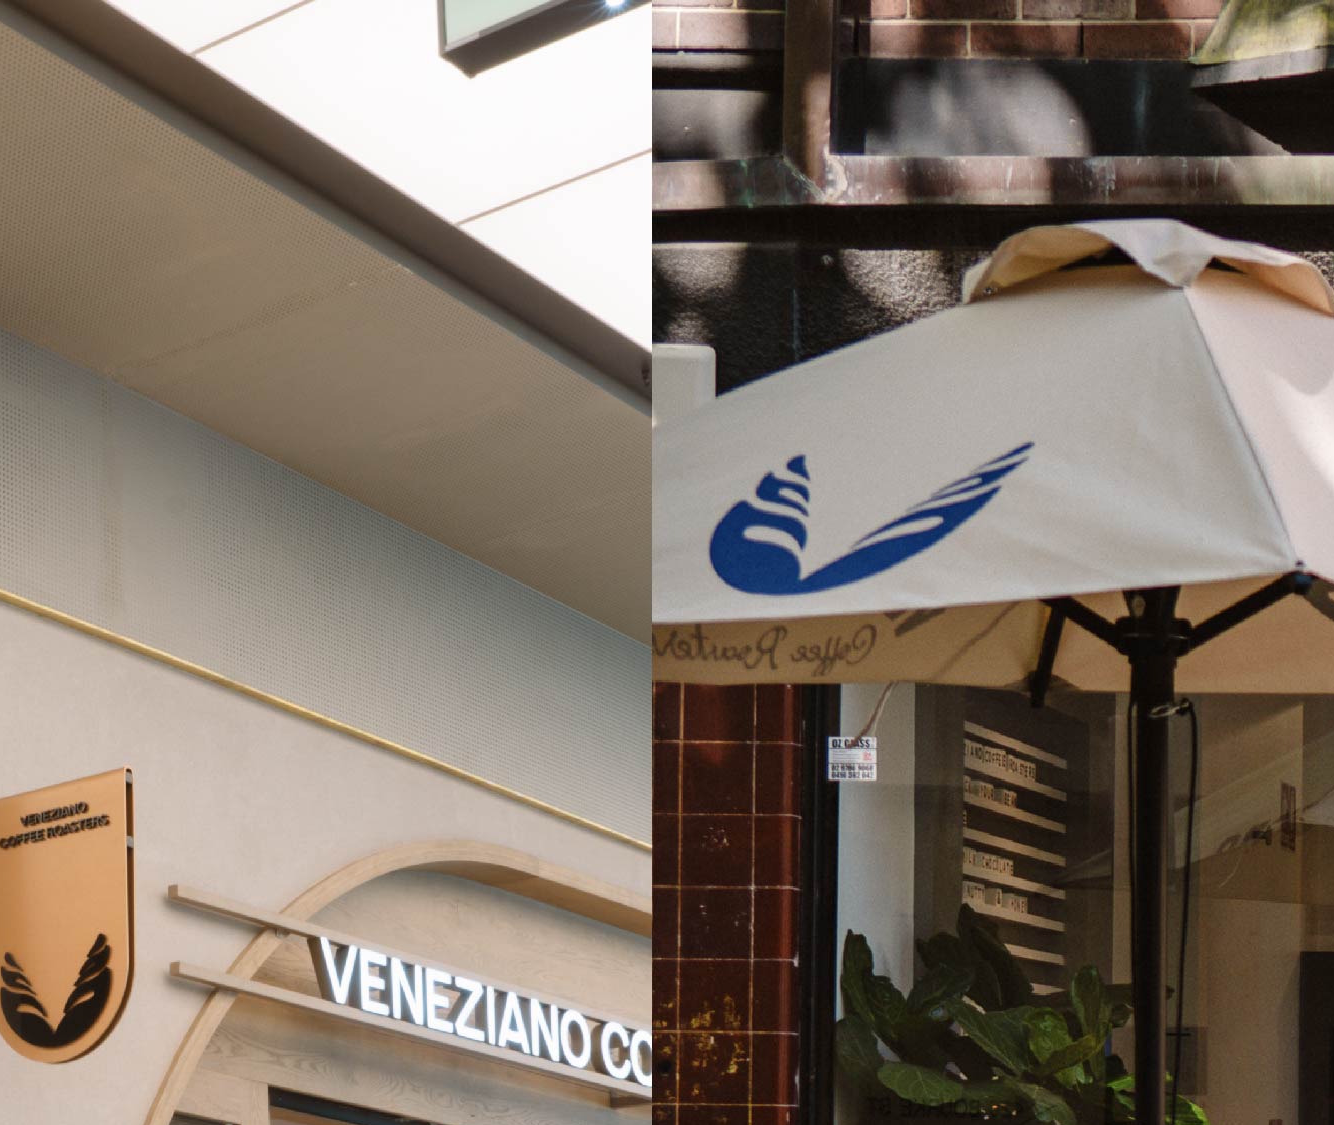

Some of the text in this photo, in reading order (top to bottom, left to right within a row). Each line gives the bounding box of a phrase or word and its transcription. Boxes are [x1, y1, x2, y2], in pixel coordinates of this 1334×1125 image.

[0, 814, 111, 850] COFFEE ROASTERS
[20, 802, 89, 827] VENEZIANO
[319, 936, 591, 1069] VENEZIANO
